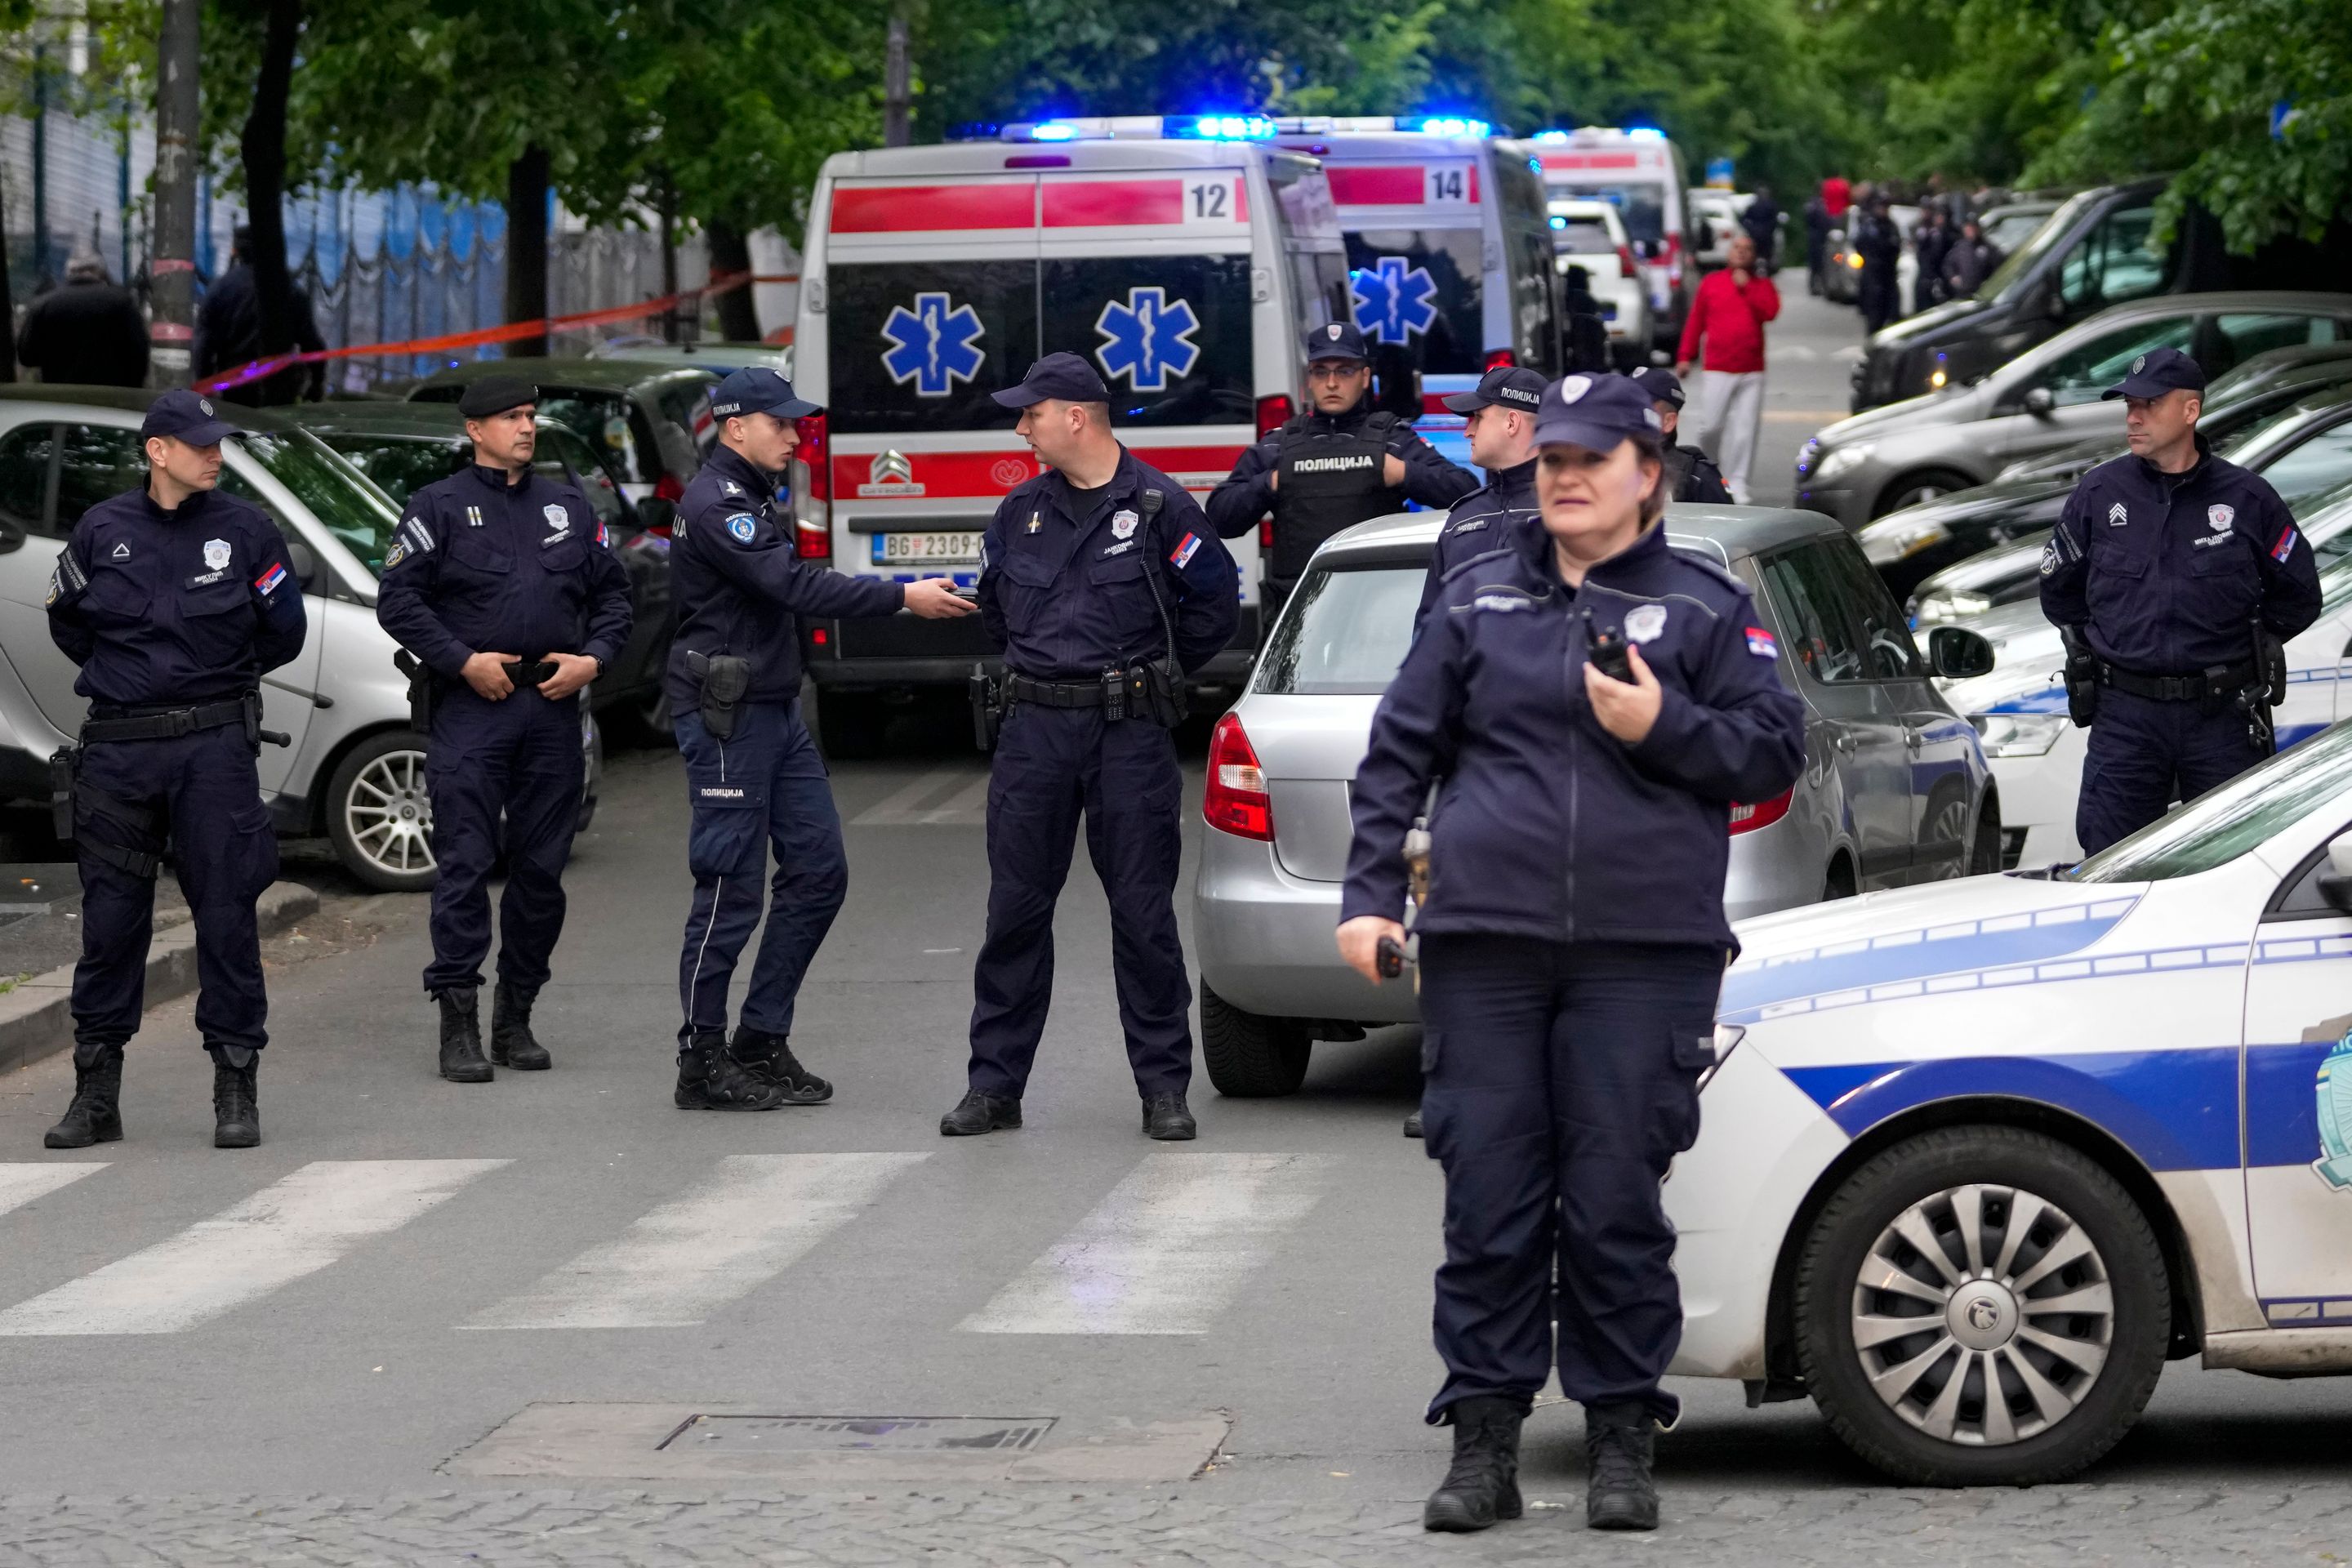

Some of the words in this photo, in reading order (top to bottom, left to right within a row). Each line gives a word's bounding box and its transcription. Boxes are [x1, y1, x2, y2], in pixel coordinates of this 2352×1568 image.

[1432, 171, 1462, 199] 14
[1191, 184, 1227, 217] 12
[1501, 387, 1539, 405] ПОЛИЦИЈА
[713, 403, 741, 415] ПОЛИЦИЈА
[1294, 456, 1374, 471] ПОЛИЦИЈА
[725, 512, 752, 523] ПОЛИЦИЈА
[888, 537, 909, 555] BG
[702, 788, 744, 798] ПОЛИЦИЈА
